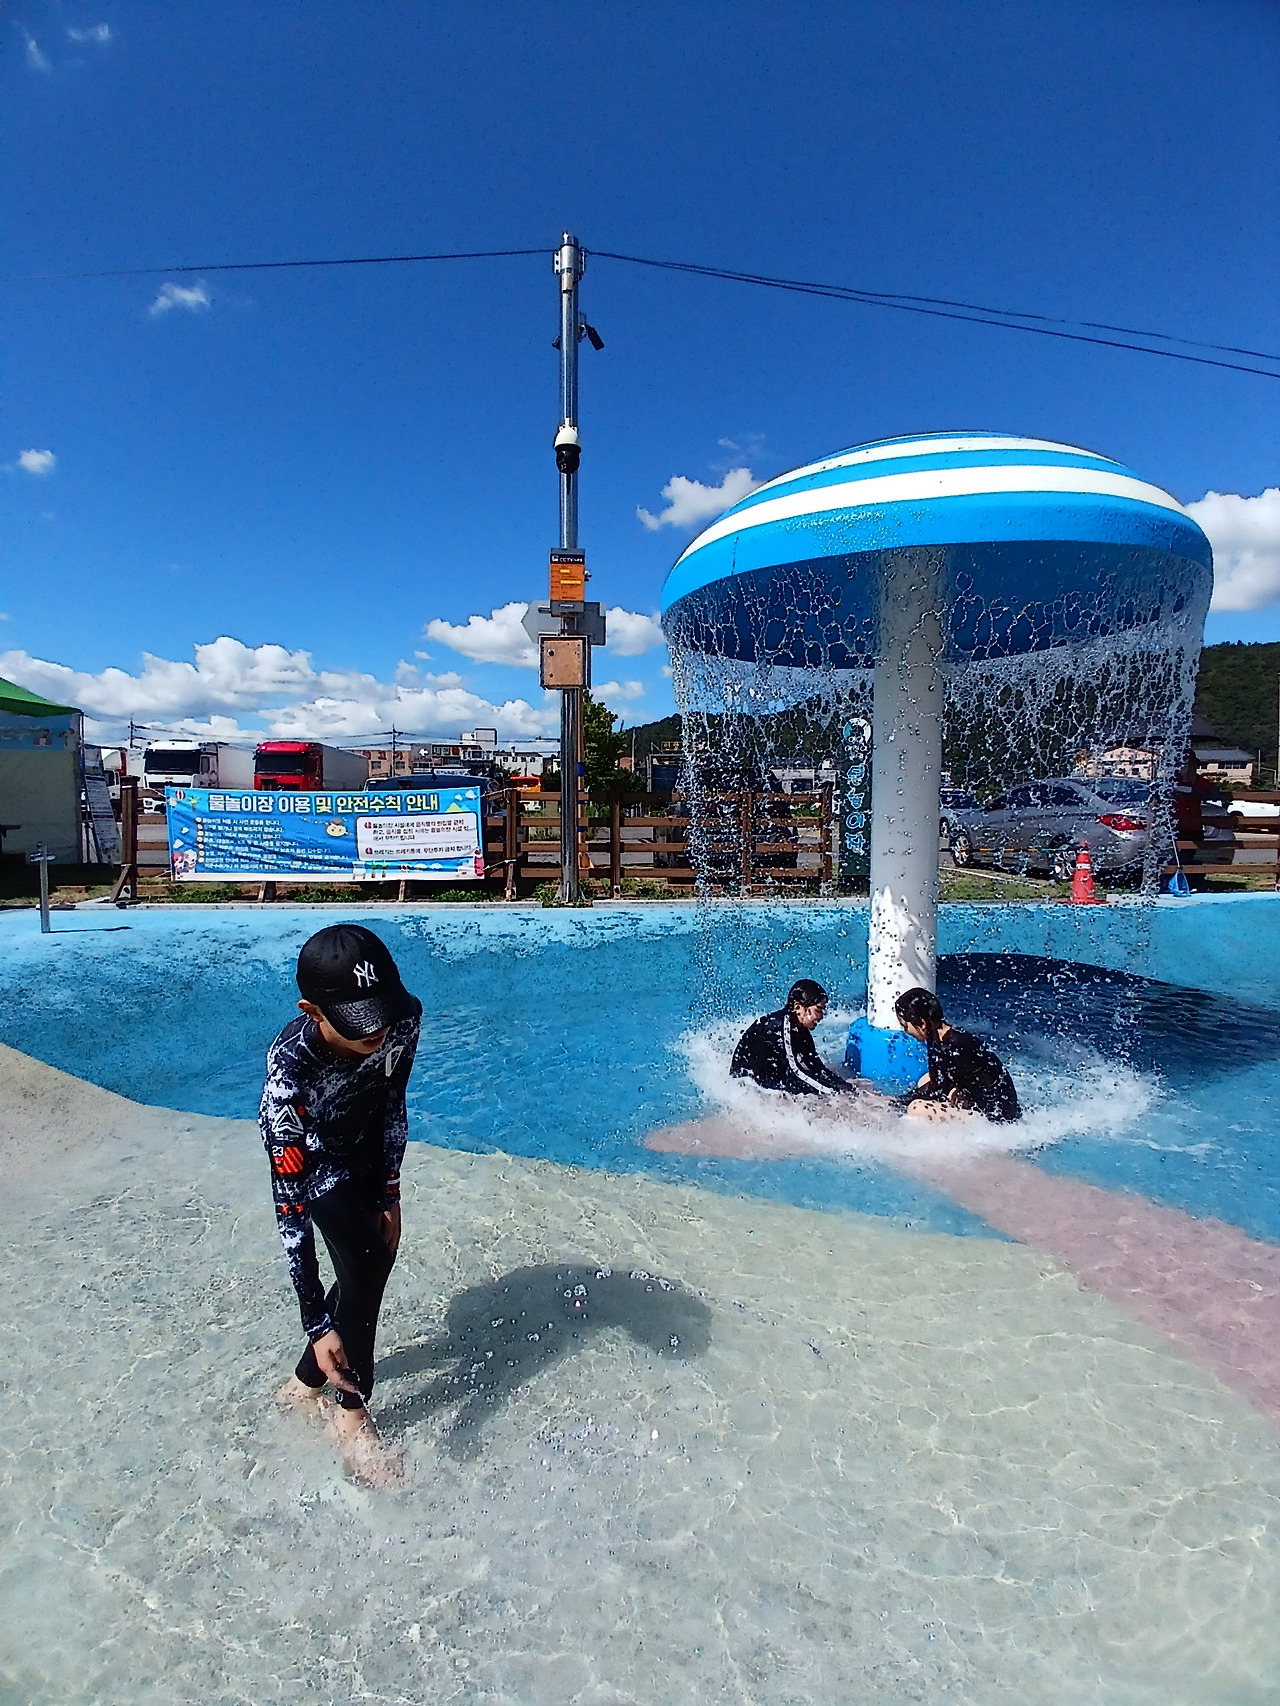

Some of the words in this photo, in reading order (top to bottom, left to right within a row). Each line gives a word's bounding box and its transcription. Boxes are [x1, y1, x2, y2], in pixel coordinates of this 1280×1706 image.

[209, 794, 274, 813] 물놀이장
[278, 796, 311, 813] 이용
[315, 796, 332, 813] 및
[336, 795, 402, 813] 안전수칙
[406, 794, 438, 811] 안내
[272, 1145, 284, 1157] 23
